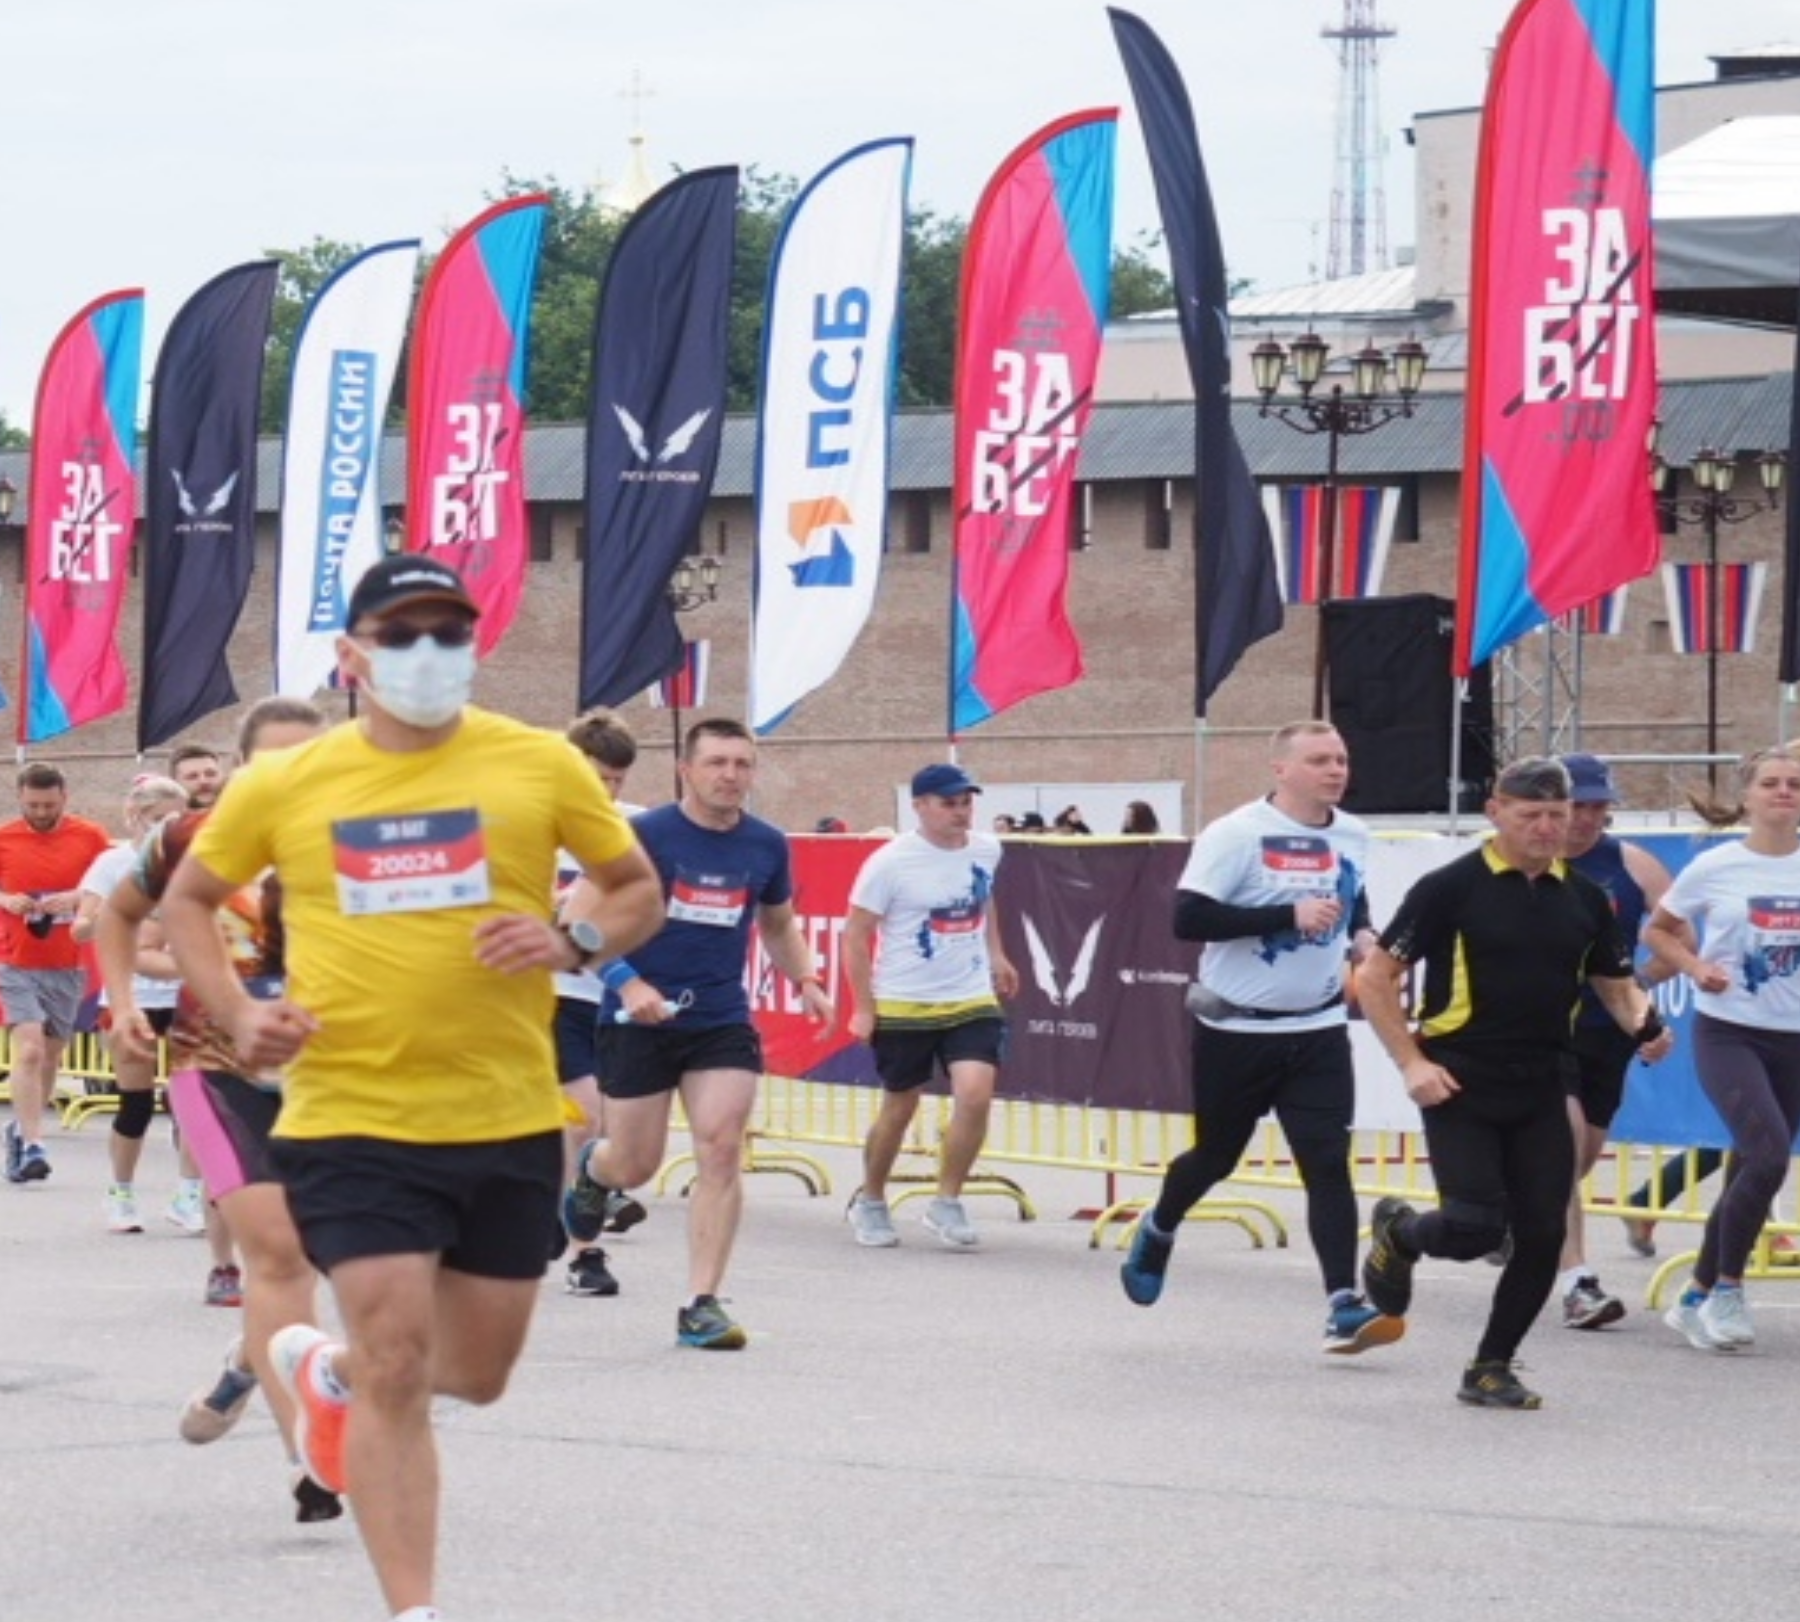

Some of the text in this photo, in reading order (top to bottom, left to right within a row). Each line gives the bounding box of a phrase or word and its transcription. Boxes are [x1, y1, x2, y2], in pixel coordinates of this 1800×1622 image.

[1541, 207, 1633, 304] ЗА
[806, 286, 871, 469] ПСБ
[987, 350, 1076, 436] ЗА
[1522, 304, 1640, 403] БЕГ
[330, 360, 367, 498] РОССИИ
[61, 461, 107, 523] ЗА
[367, 850, 449, 878] 20024
